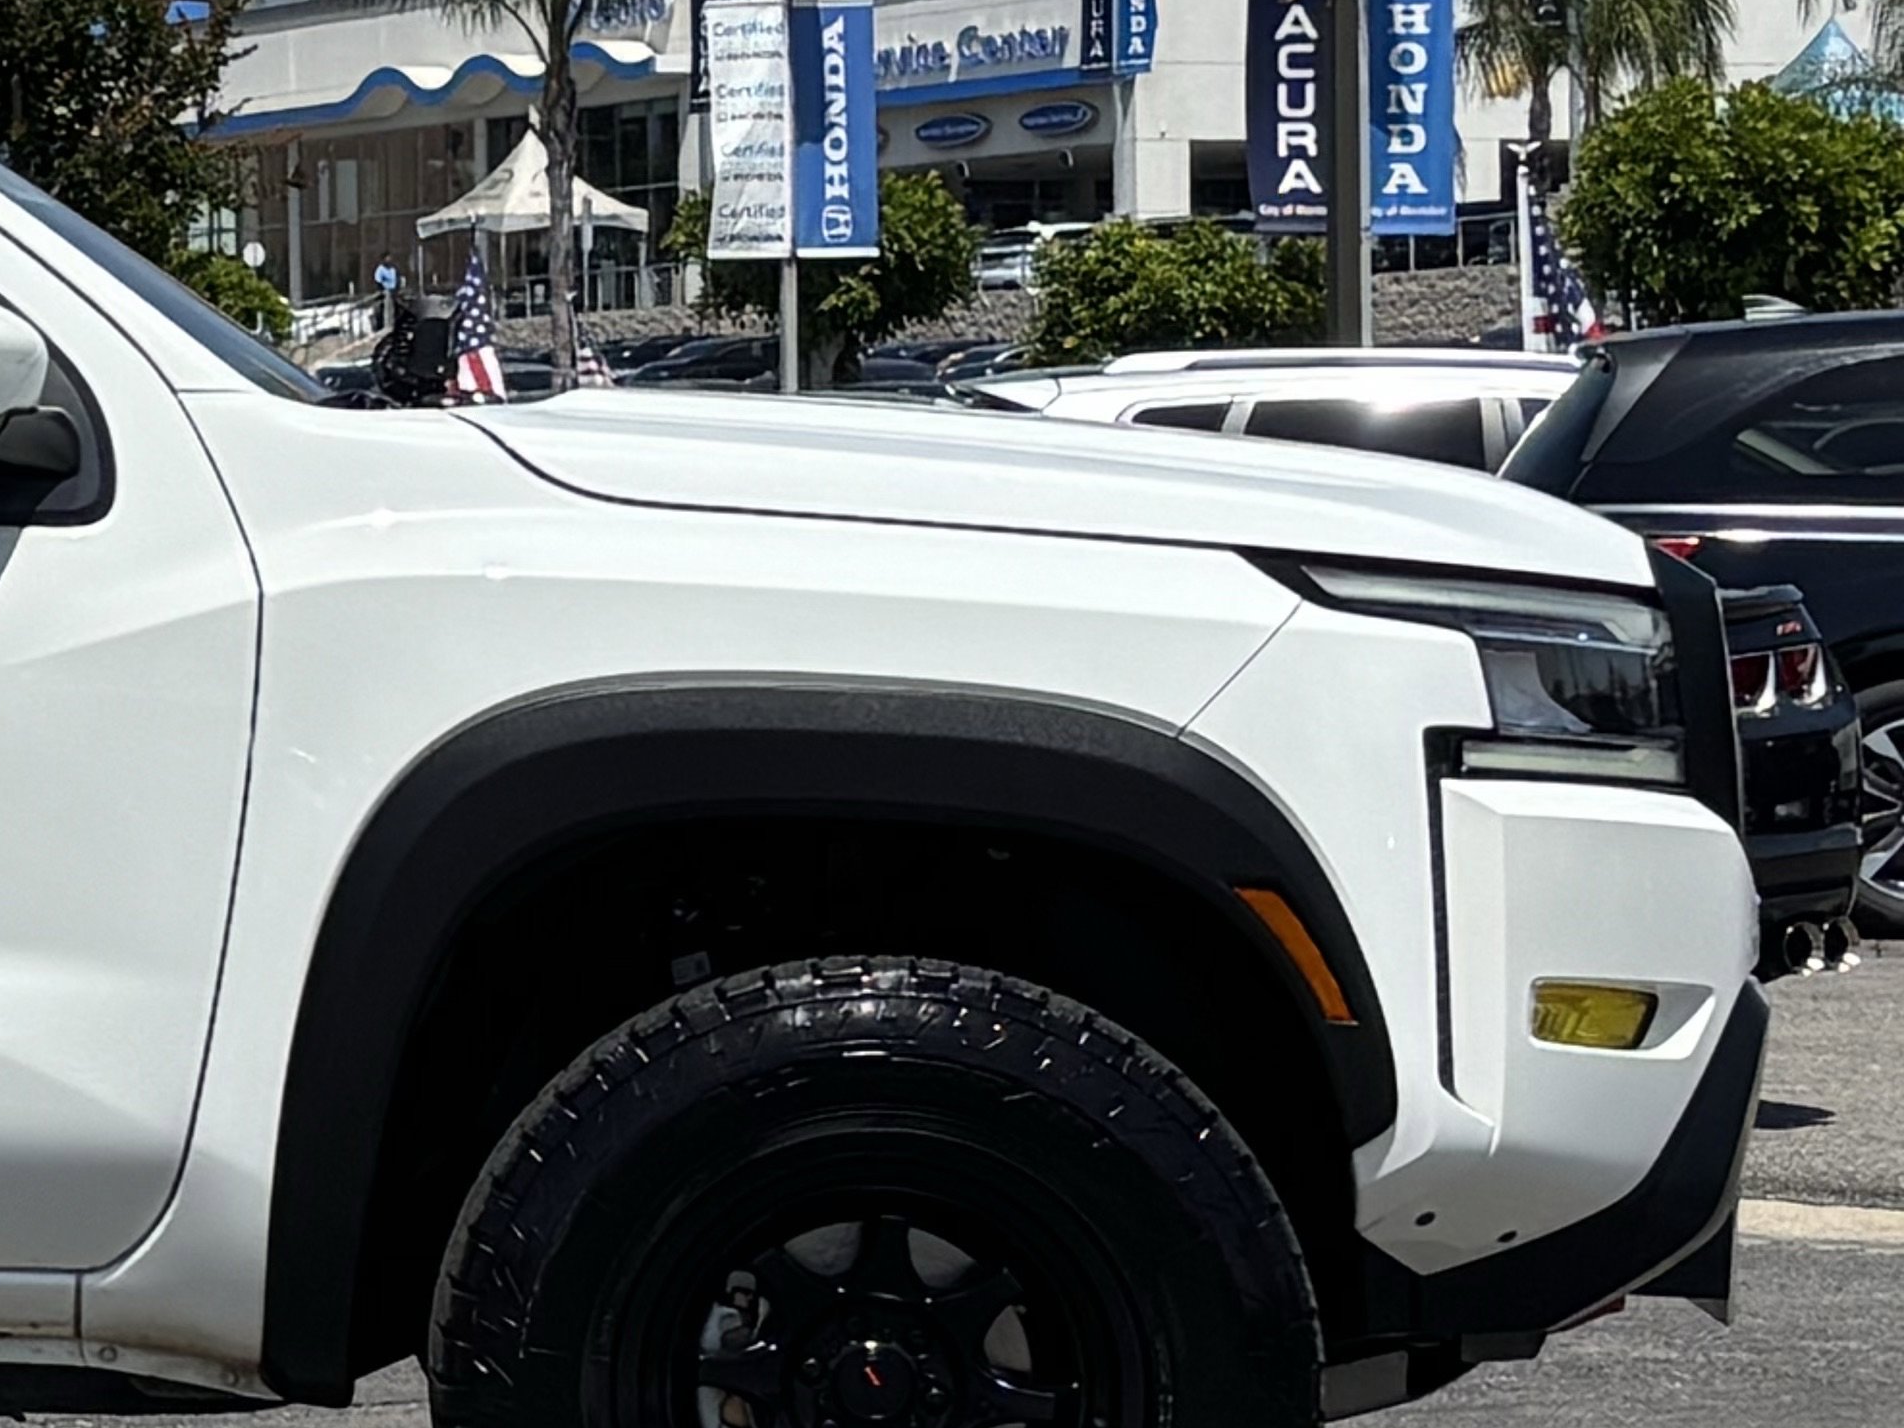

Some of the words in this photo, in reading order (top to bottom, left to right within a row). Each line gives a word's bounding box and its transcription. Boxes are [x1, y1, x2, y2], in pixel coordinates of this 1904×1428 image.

[822, 14, 850, 200] HONDA
[1274, 3, 1323, 194] ACURA
[1382, 2, 1431, 194] HONDA
